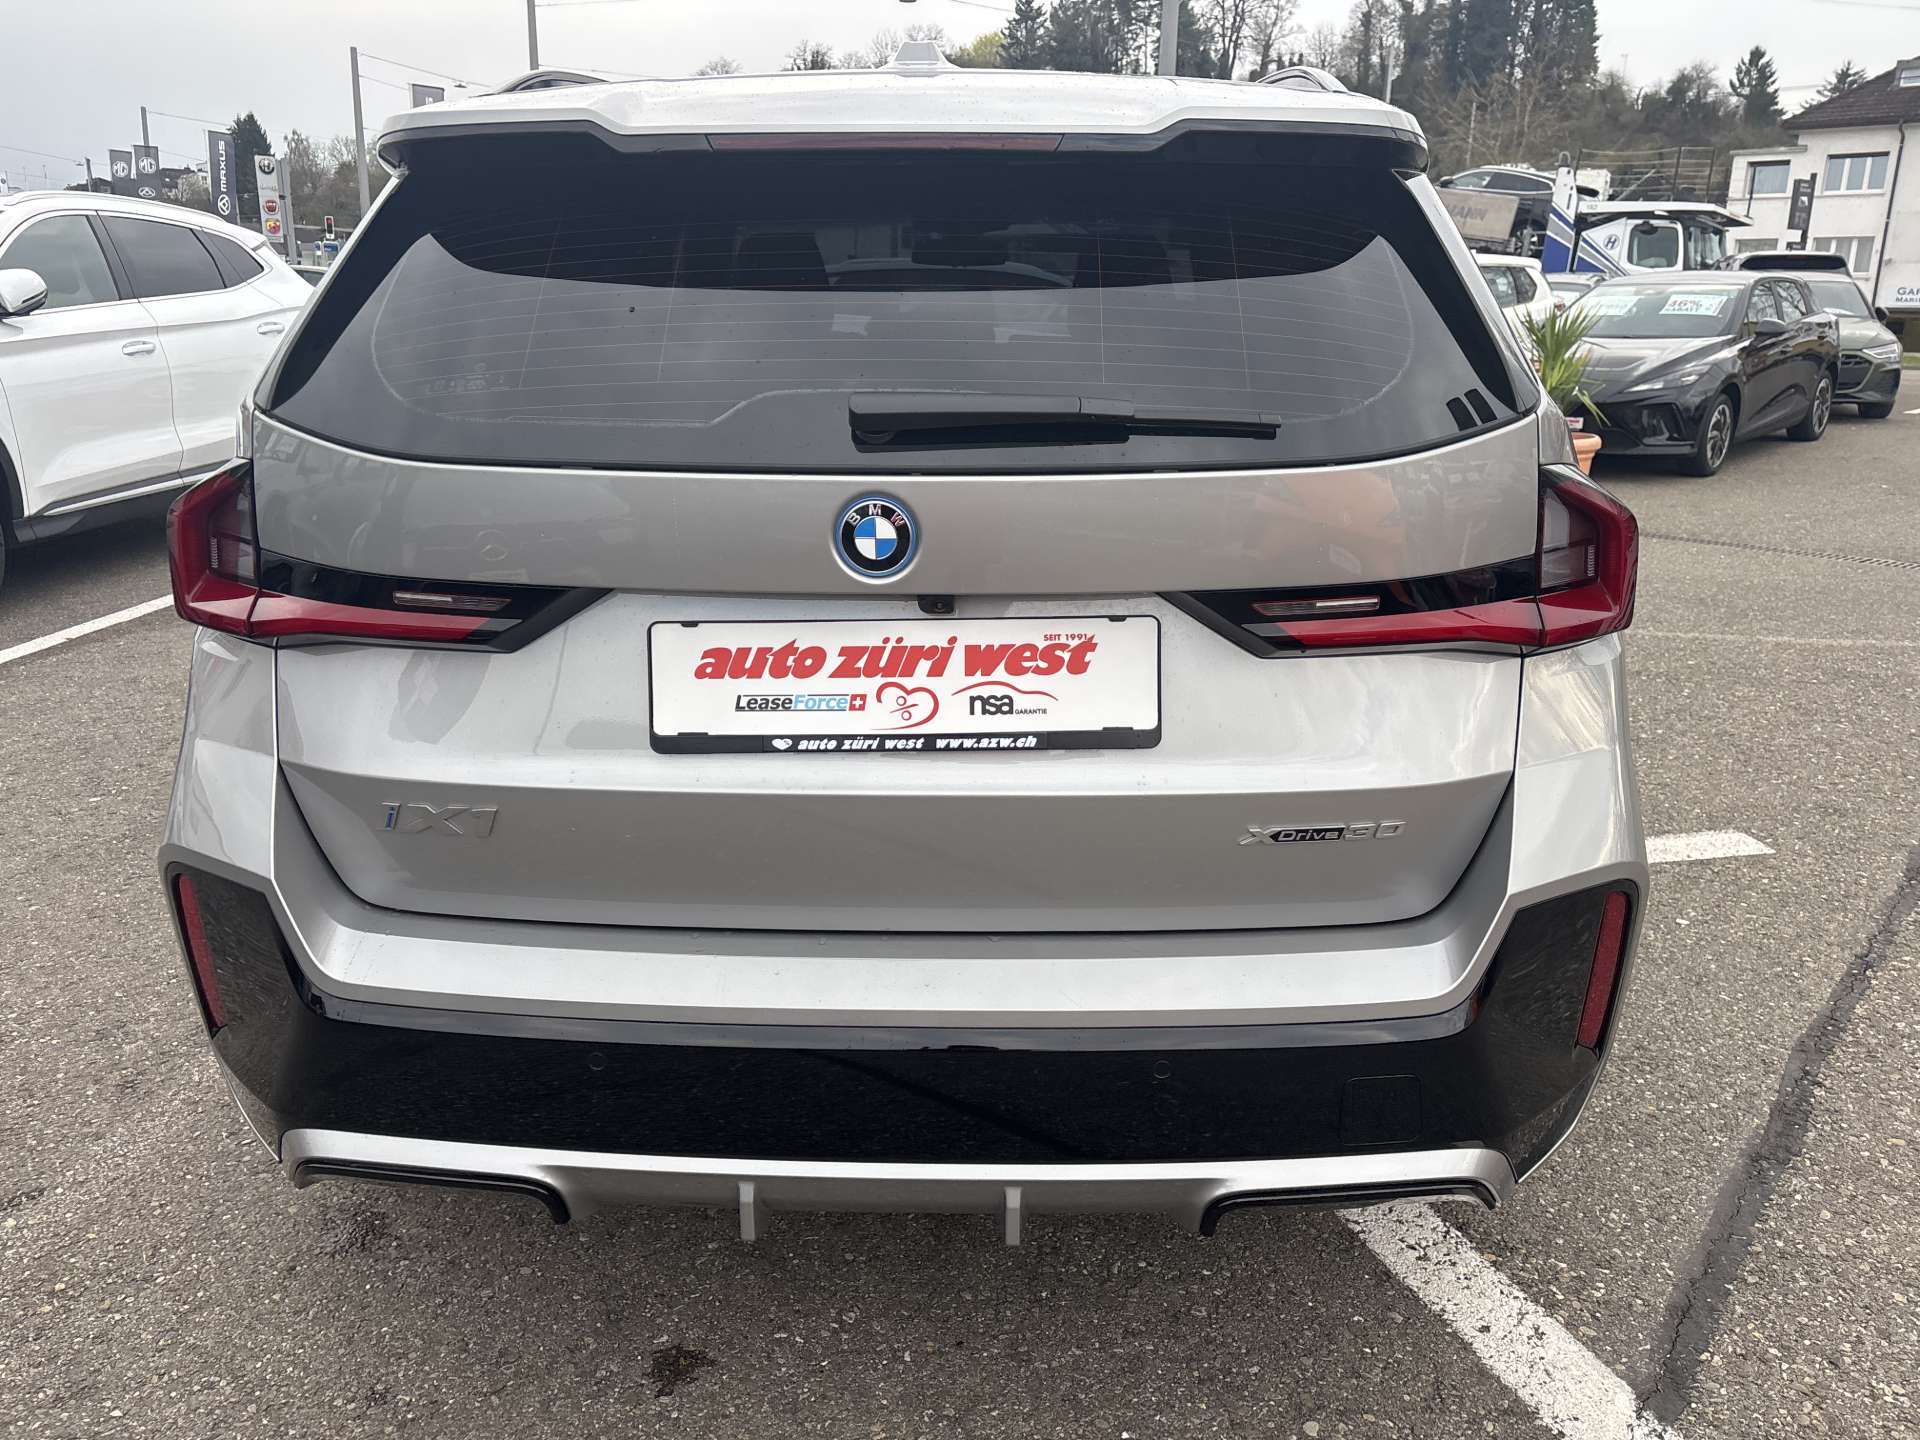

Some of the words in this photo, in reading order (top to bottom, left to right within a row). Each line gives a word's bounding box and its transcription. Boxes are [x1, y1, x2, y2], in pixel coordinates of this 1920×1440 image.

[112, 161, 128, 177] MG
[139, 157, 156, 174] MG
[848, 503, 905, 526] BMW
[1065, 633, 1087, 641] 1991
[694, 638, 827, 679] auto
[828, 635, 958, 678] züri
[964, 634, 1098, 677] west
[735, 694, 848, 711] LeaseForce
[969, 694, 1014, 715] nsa
[797, 738, 837, 750] auto
[841, 736, 879, 750] züri
[884, 736, 925, 749] west
[935, 735, 1038, 749] www.azw.ch
